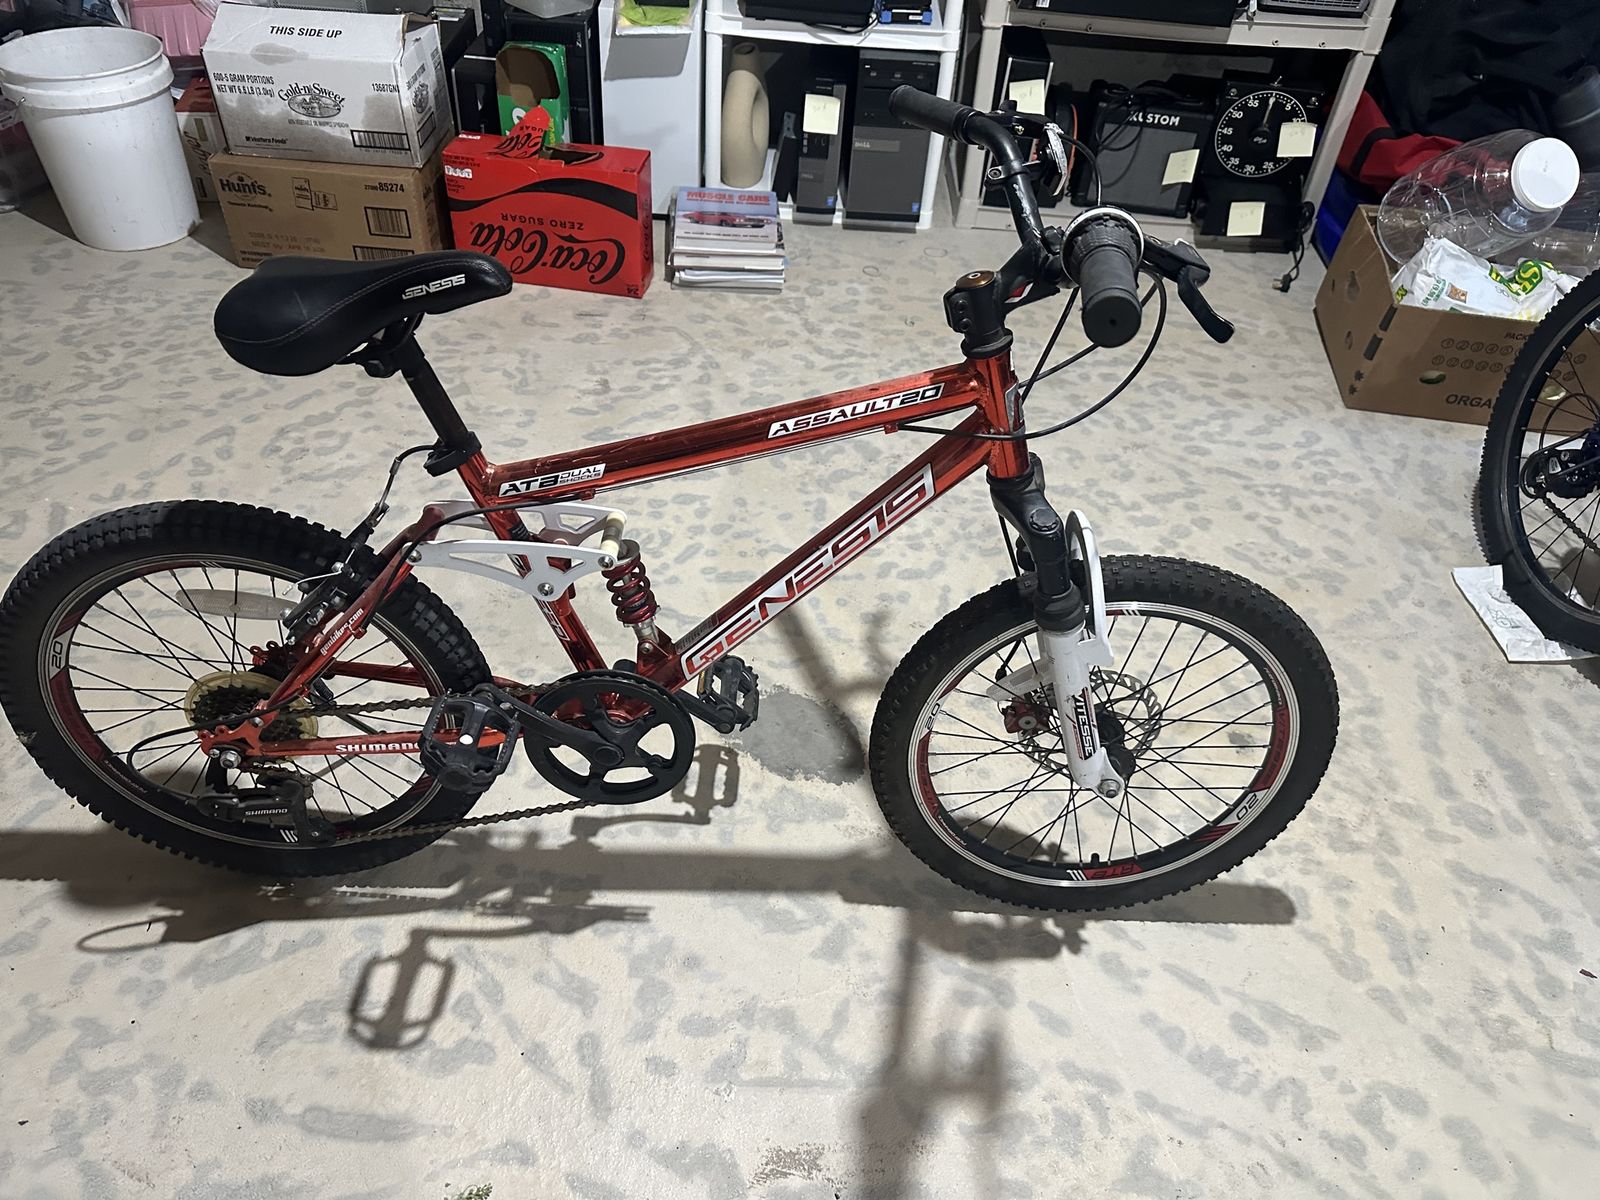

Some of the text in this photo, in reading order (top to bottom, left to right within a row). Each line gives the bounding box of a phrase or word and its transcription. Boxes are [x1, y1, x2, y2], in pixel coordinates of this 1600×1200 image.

[269, 25, 343, 39] THIS SIDE UP
[229, 73, 246, 83] GRAM
[246, 74, 275, 85] PORTIONS
[216, 84, 228, 93] NET
[228, 85, 237, 94] WT
[1247, 99, 1260, 108] 55
[1285, 102, 1292, 111] 5
[1231, 110, 1244, 119] 50
[1222, 127, 1234, 136] 45
[1221, 144, 1233, 152] 40
[1229, 157, 1240, 166] 35
[1262, 161, 1275, 170] 25
[1244, 164, 1256, 174] 30
[378, 182, 405, 193] 85274
[500, 212, 585, 231] ZERO SUGAR
[470, 221, 626, 285] Coca-Cola
[402, 273, 466, 300] GENESIS
[1445, 393, 1493, 409] ORGA
[500, 465, 602, 496] ATB DUAL
[684, 471, 928, 677] GENESIS
[50, 640, 64, 669] 20
[925, 702, 941, 731] 20
[1075, 695, 1095, 757] VITESSE
[245, 808, 288, 816] SHIMANO
[1236, 792, 1260, 821] 20
